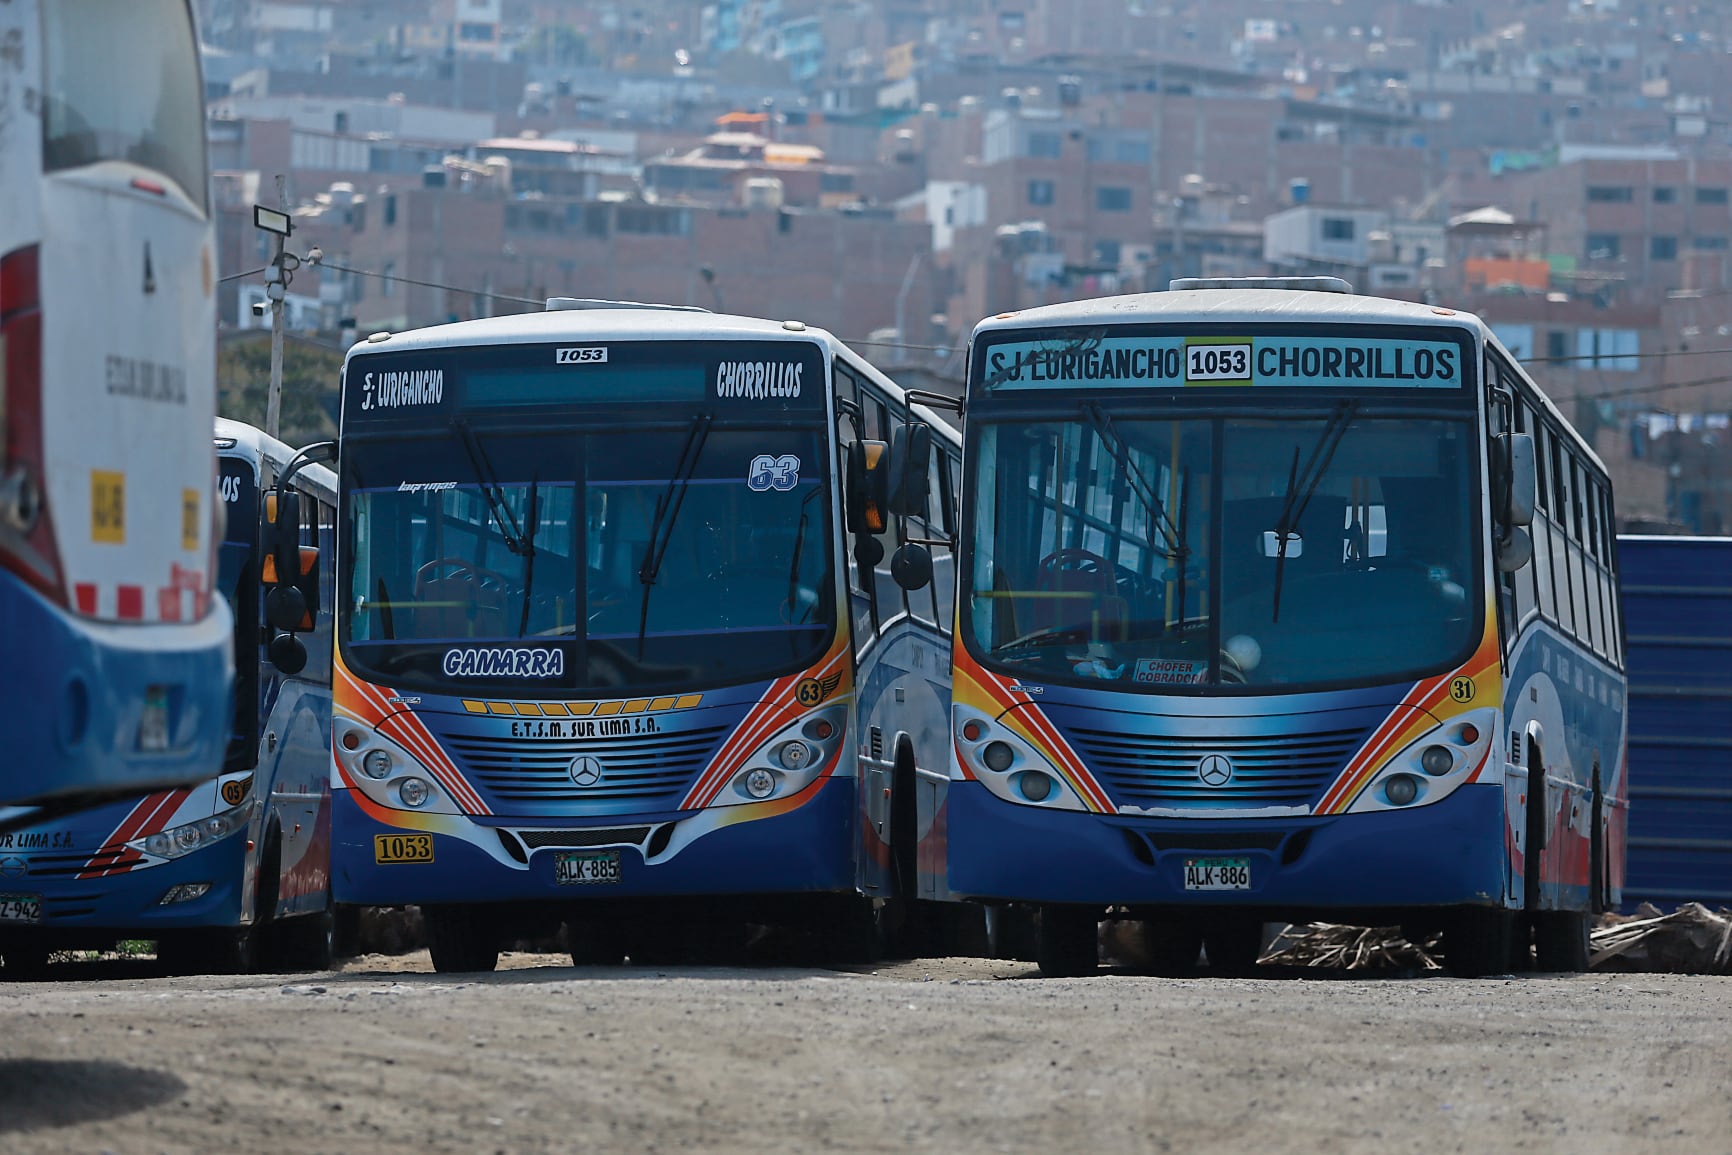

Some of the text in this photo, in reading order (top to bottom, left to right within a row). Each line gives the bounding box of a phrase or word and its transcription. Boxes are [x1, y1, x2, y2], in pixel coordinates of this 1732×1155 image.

[560, 349, 604, 362] 1053
[1031, 349, 1180, 381] LURIGANCHO
[1191, 350, 1246, 374] 1053
[1257, 347, 1455, 379] CHORRILLOS
[377, 369, 443, 408] LURIGANCHO
[717, 361, 803, 400] CHORRILLOS
[748, 454, 801, 492] 63
[443, 648, 564, 678] GAMARRA
[1149, 661, 1193, 673] CHOFER
[800, 683, 819, 702] 63
[1454, 680, 1471, 699] 31
[511, 717, 661, 738] E.T.S.M. SUR LIMA S.A.
[227, 785, 240, 800] 05
[17, 832, 49, 849] LIMA
[52, 831, 75, 849] S.A.
[379, 836, 430, 859] 1053
[560, 860, 617, 879] ALK-885
[1187, 867, 1248, 886] ALK-886
